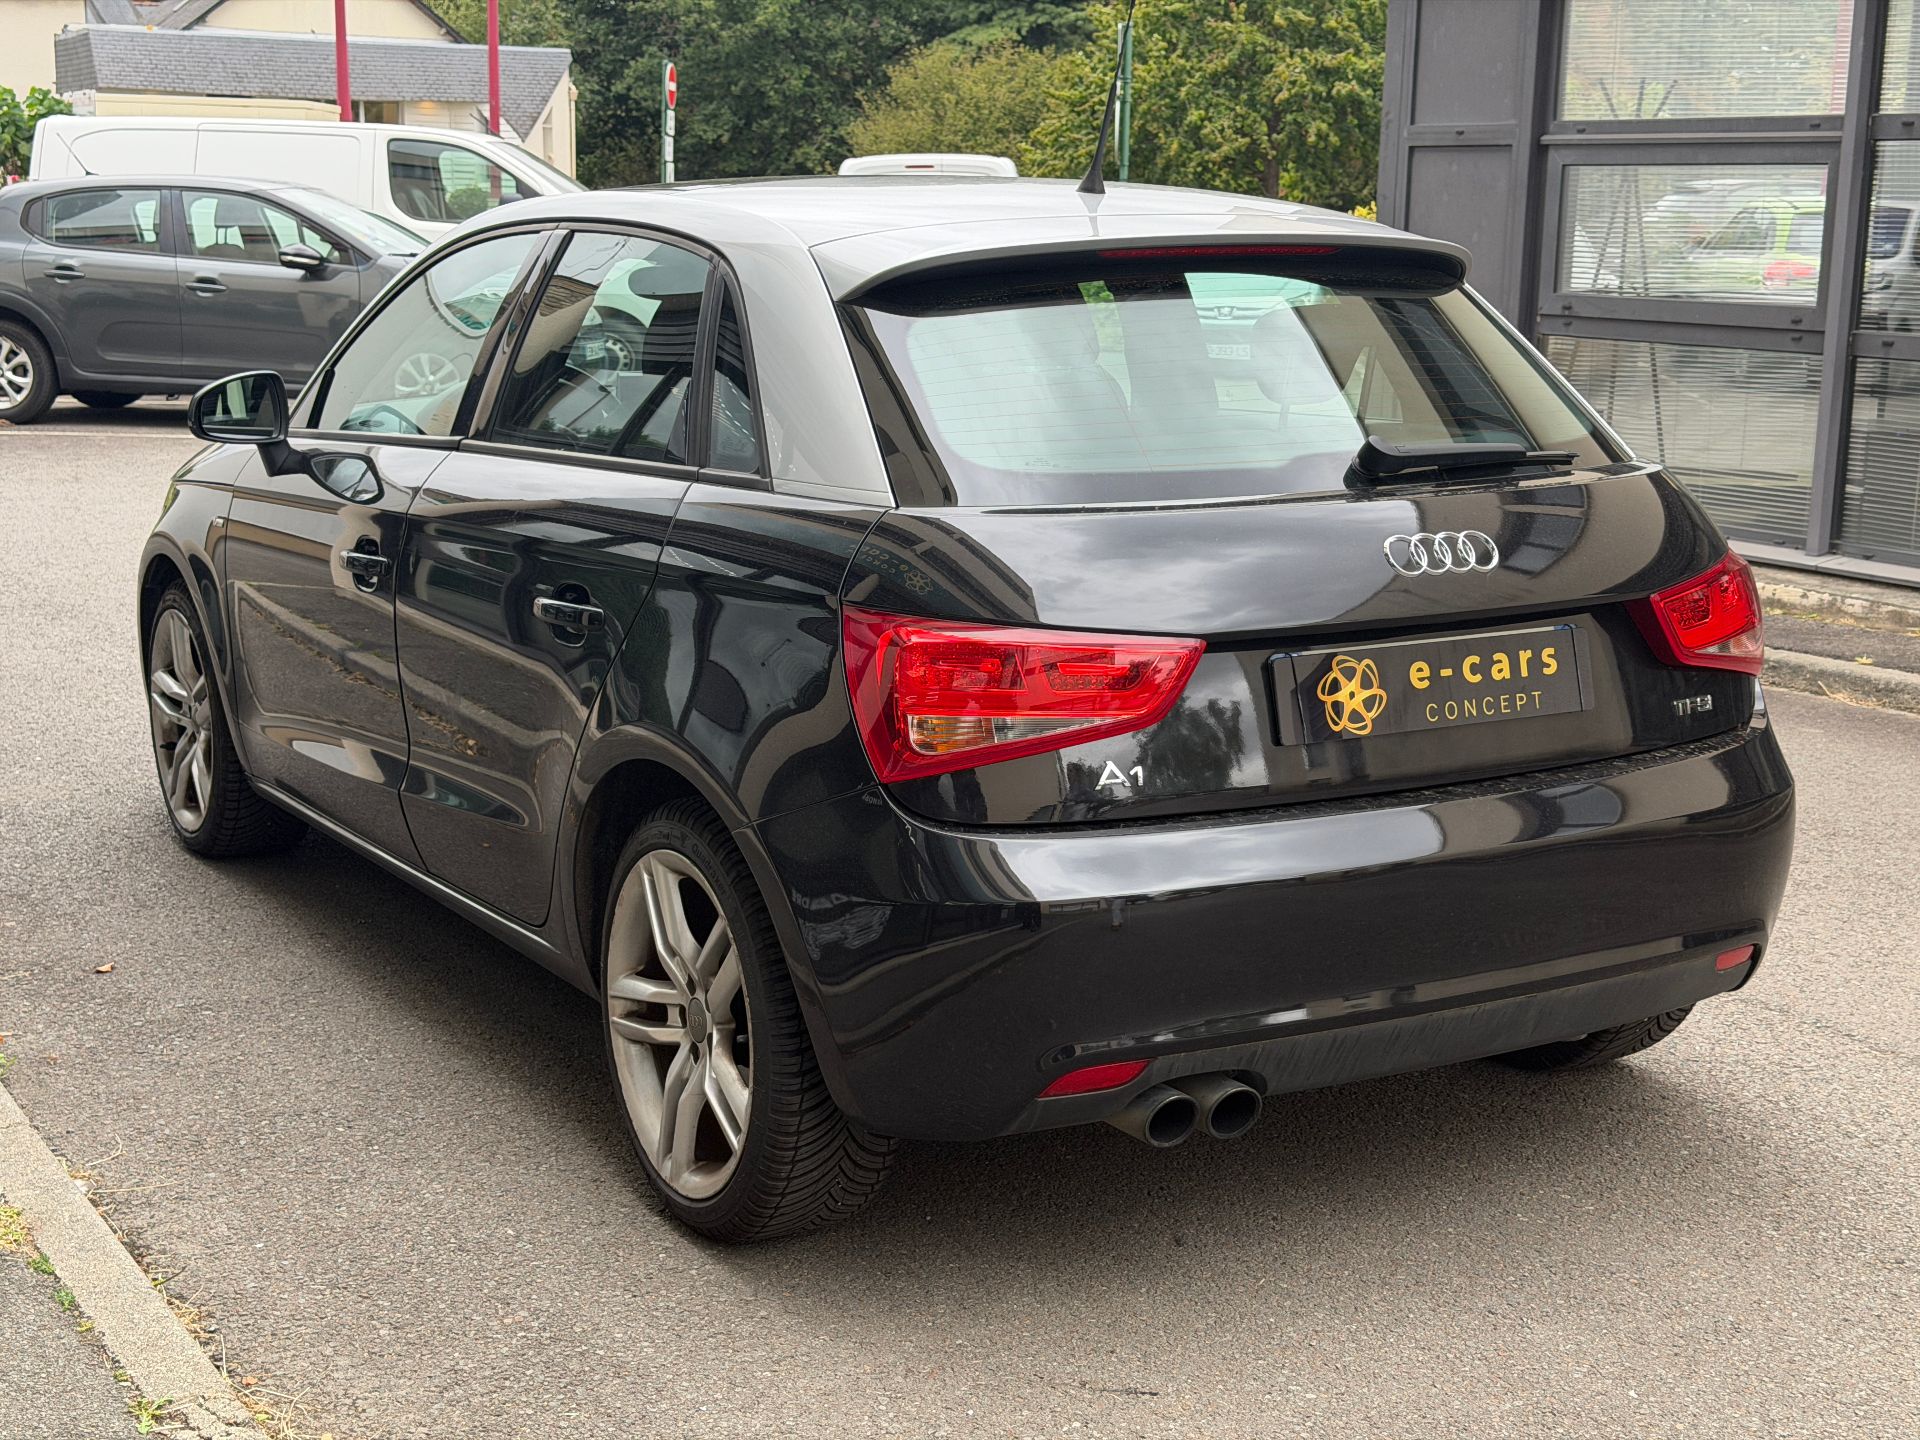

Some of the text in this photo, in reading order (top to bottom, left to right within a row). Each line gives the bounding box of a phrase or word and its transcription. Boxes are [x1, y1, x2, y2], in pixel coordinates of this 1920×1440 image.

[1409, 647, 1558, 690] e-cars
[1426, 691, 1542, 722] CONCEPT
[1094, 760, 1144, 791] A1
